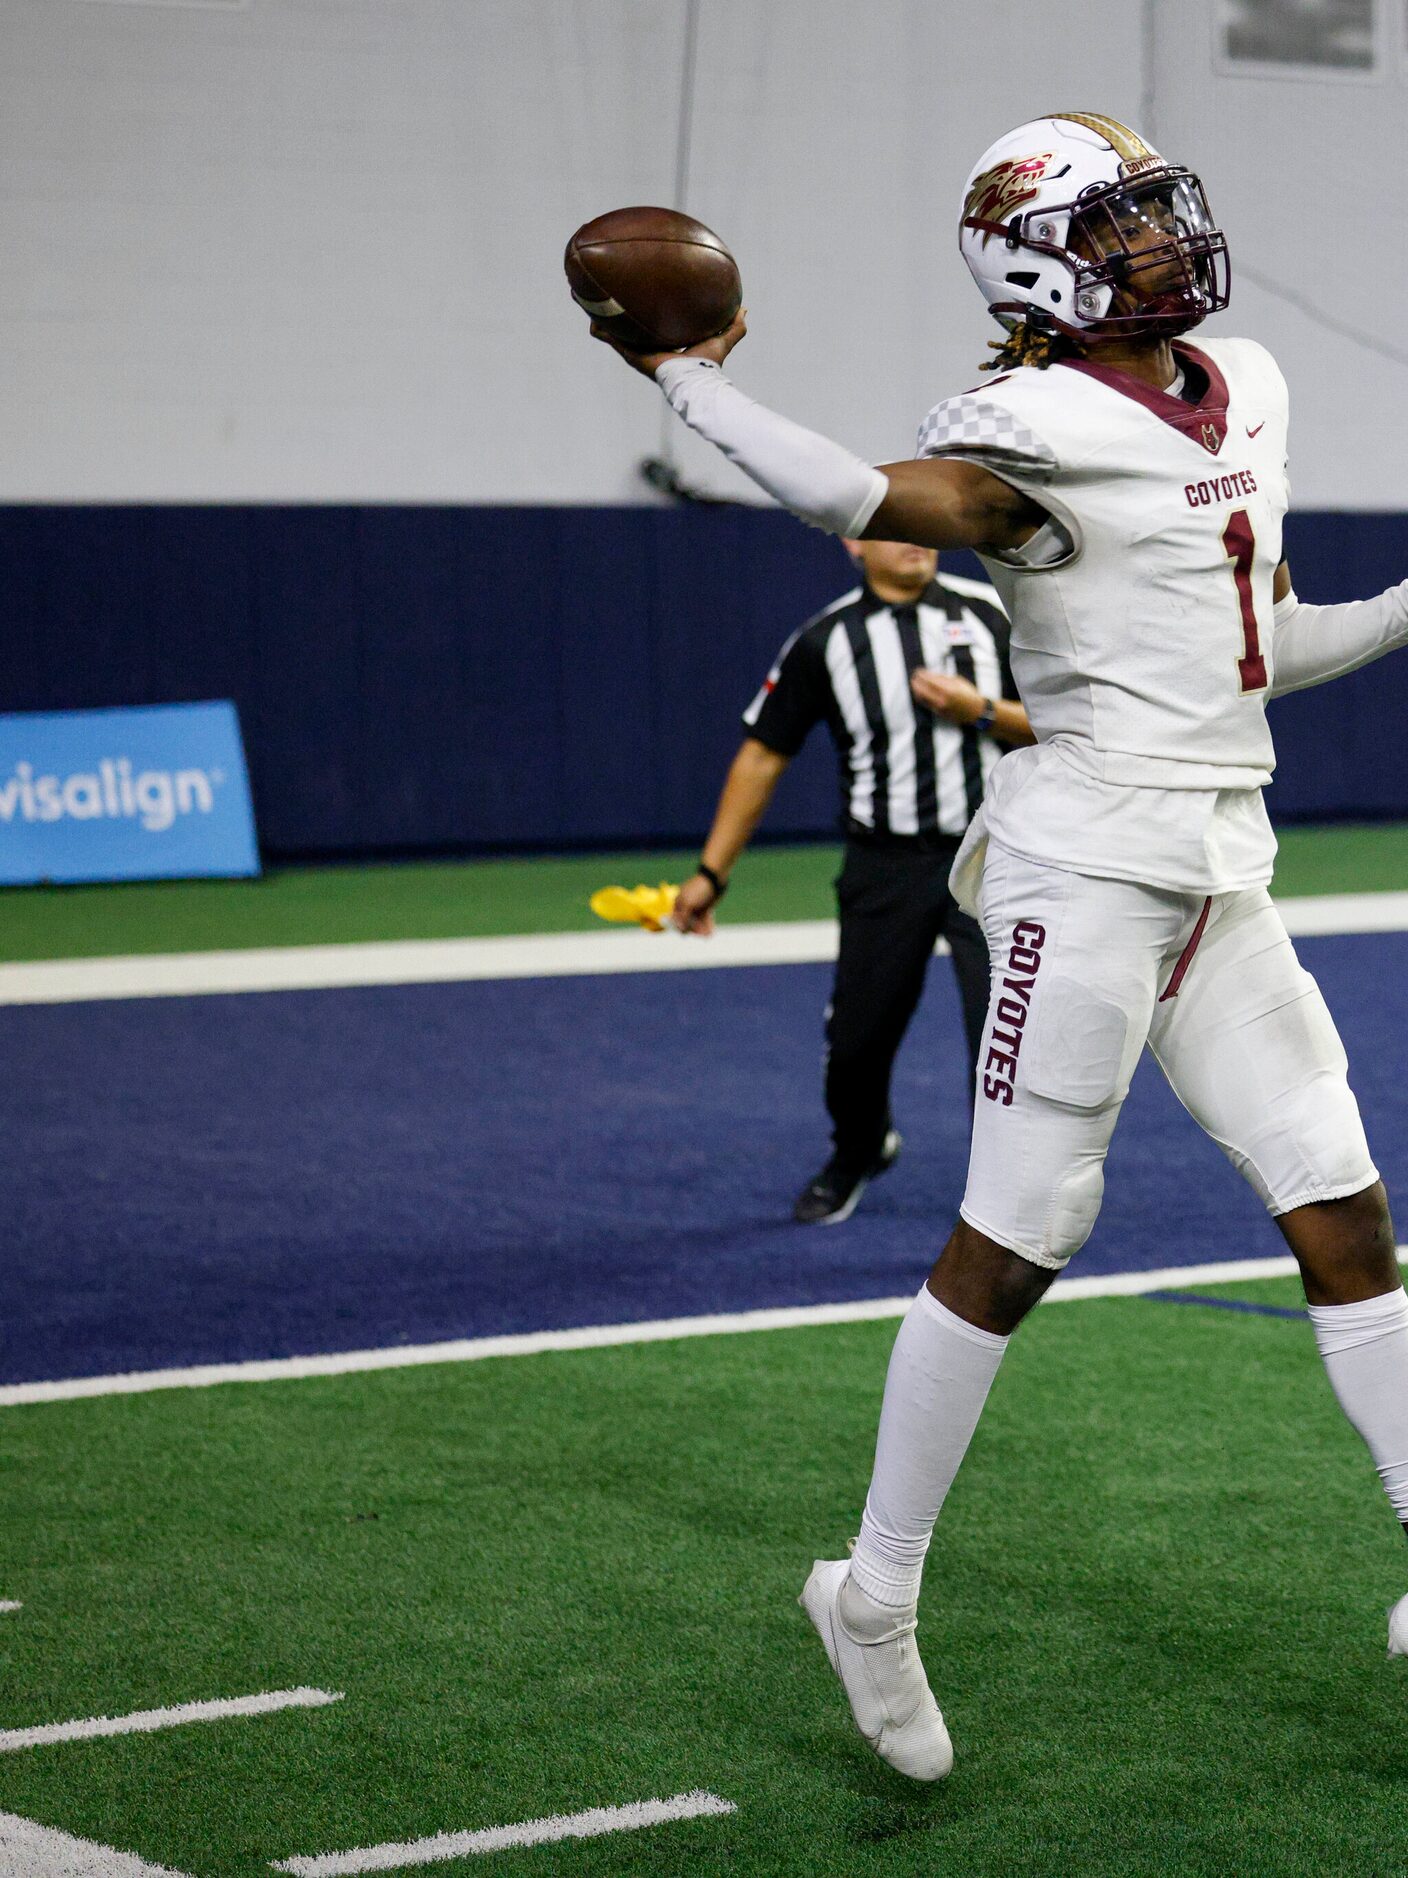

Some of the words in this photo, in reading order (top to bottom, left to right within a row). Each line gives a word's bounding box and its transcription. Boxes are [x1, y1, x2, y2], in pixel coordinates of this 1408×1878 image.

[1184, 470, 1258, 507] COYOTES
[1219, 505, 1268, 697] 1
[984, 921, 1046, 1106] COYOTES
